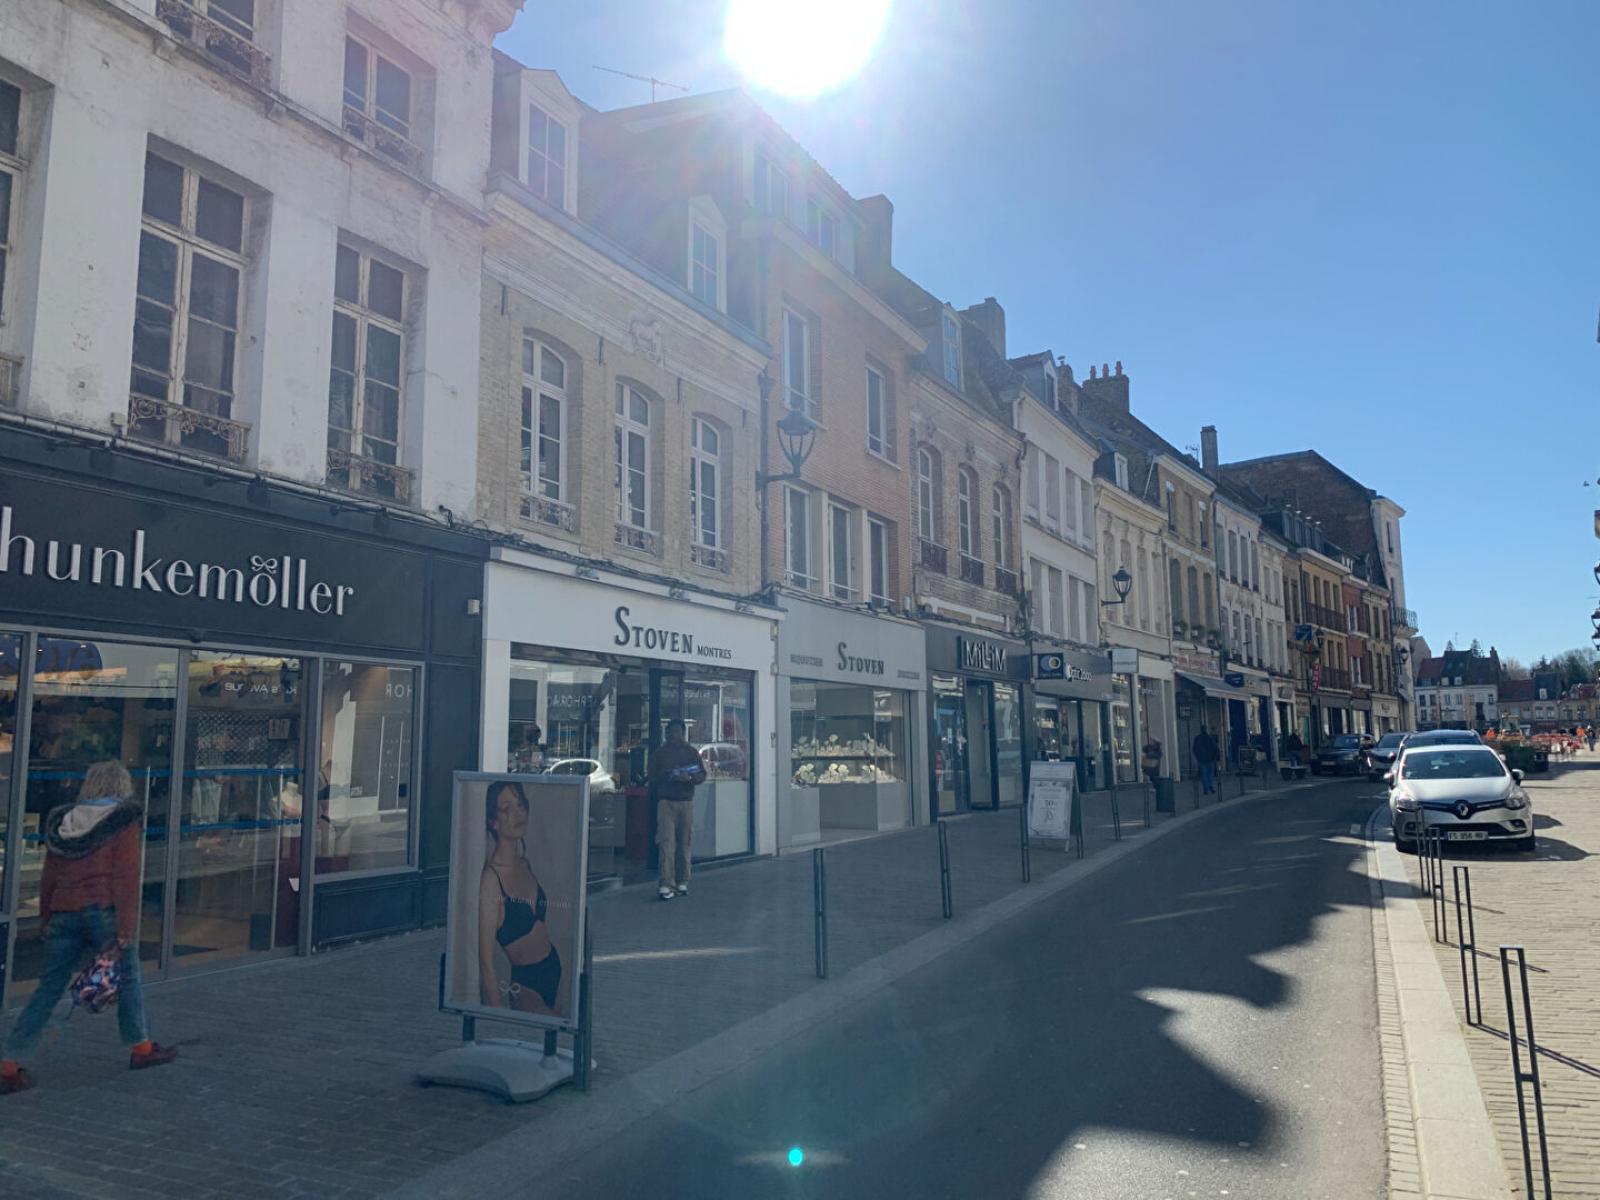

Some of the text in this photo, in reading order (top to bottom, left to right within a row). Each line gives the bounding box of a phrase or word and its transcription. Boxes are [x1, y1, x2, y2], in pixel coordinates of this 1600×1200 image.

[614, 605, 732, 660] STOVEN MONTRES
[838, 641, 884, 675] STOVEN
